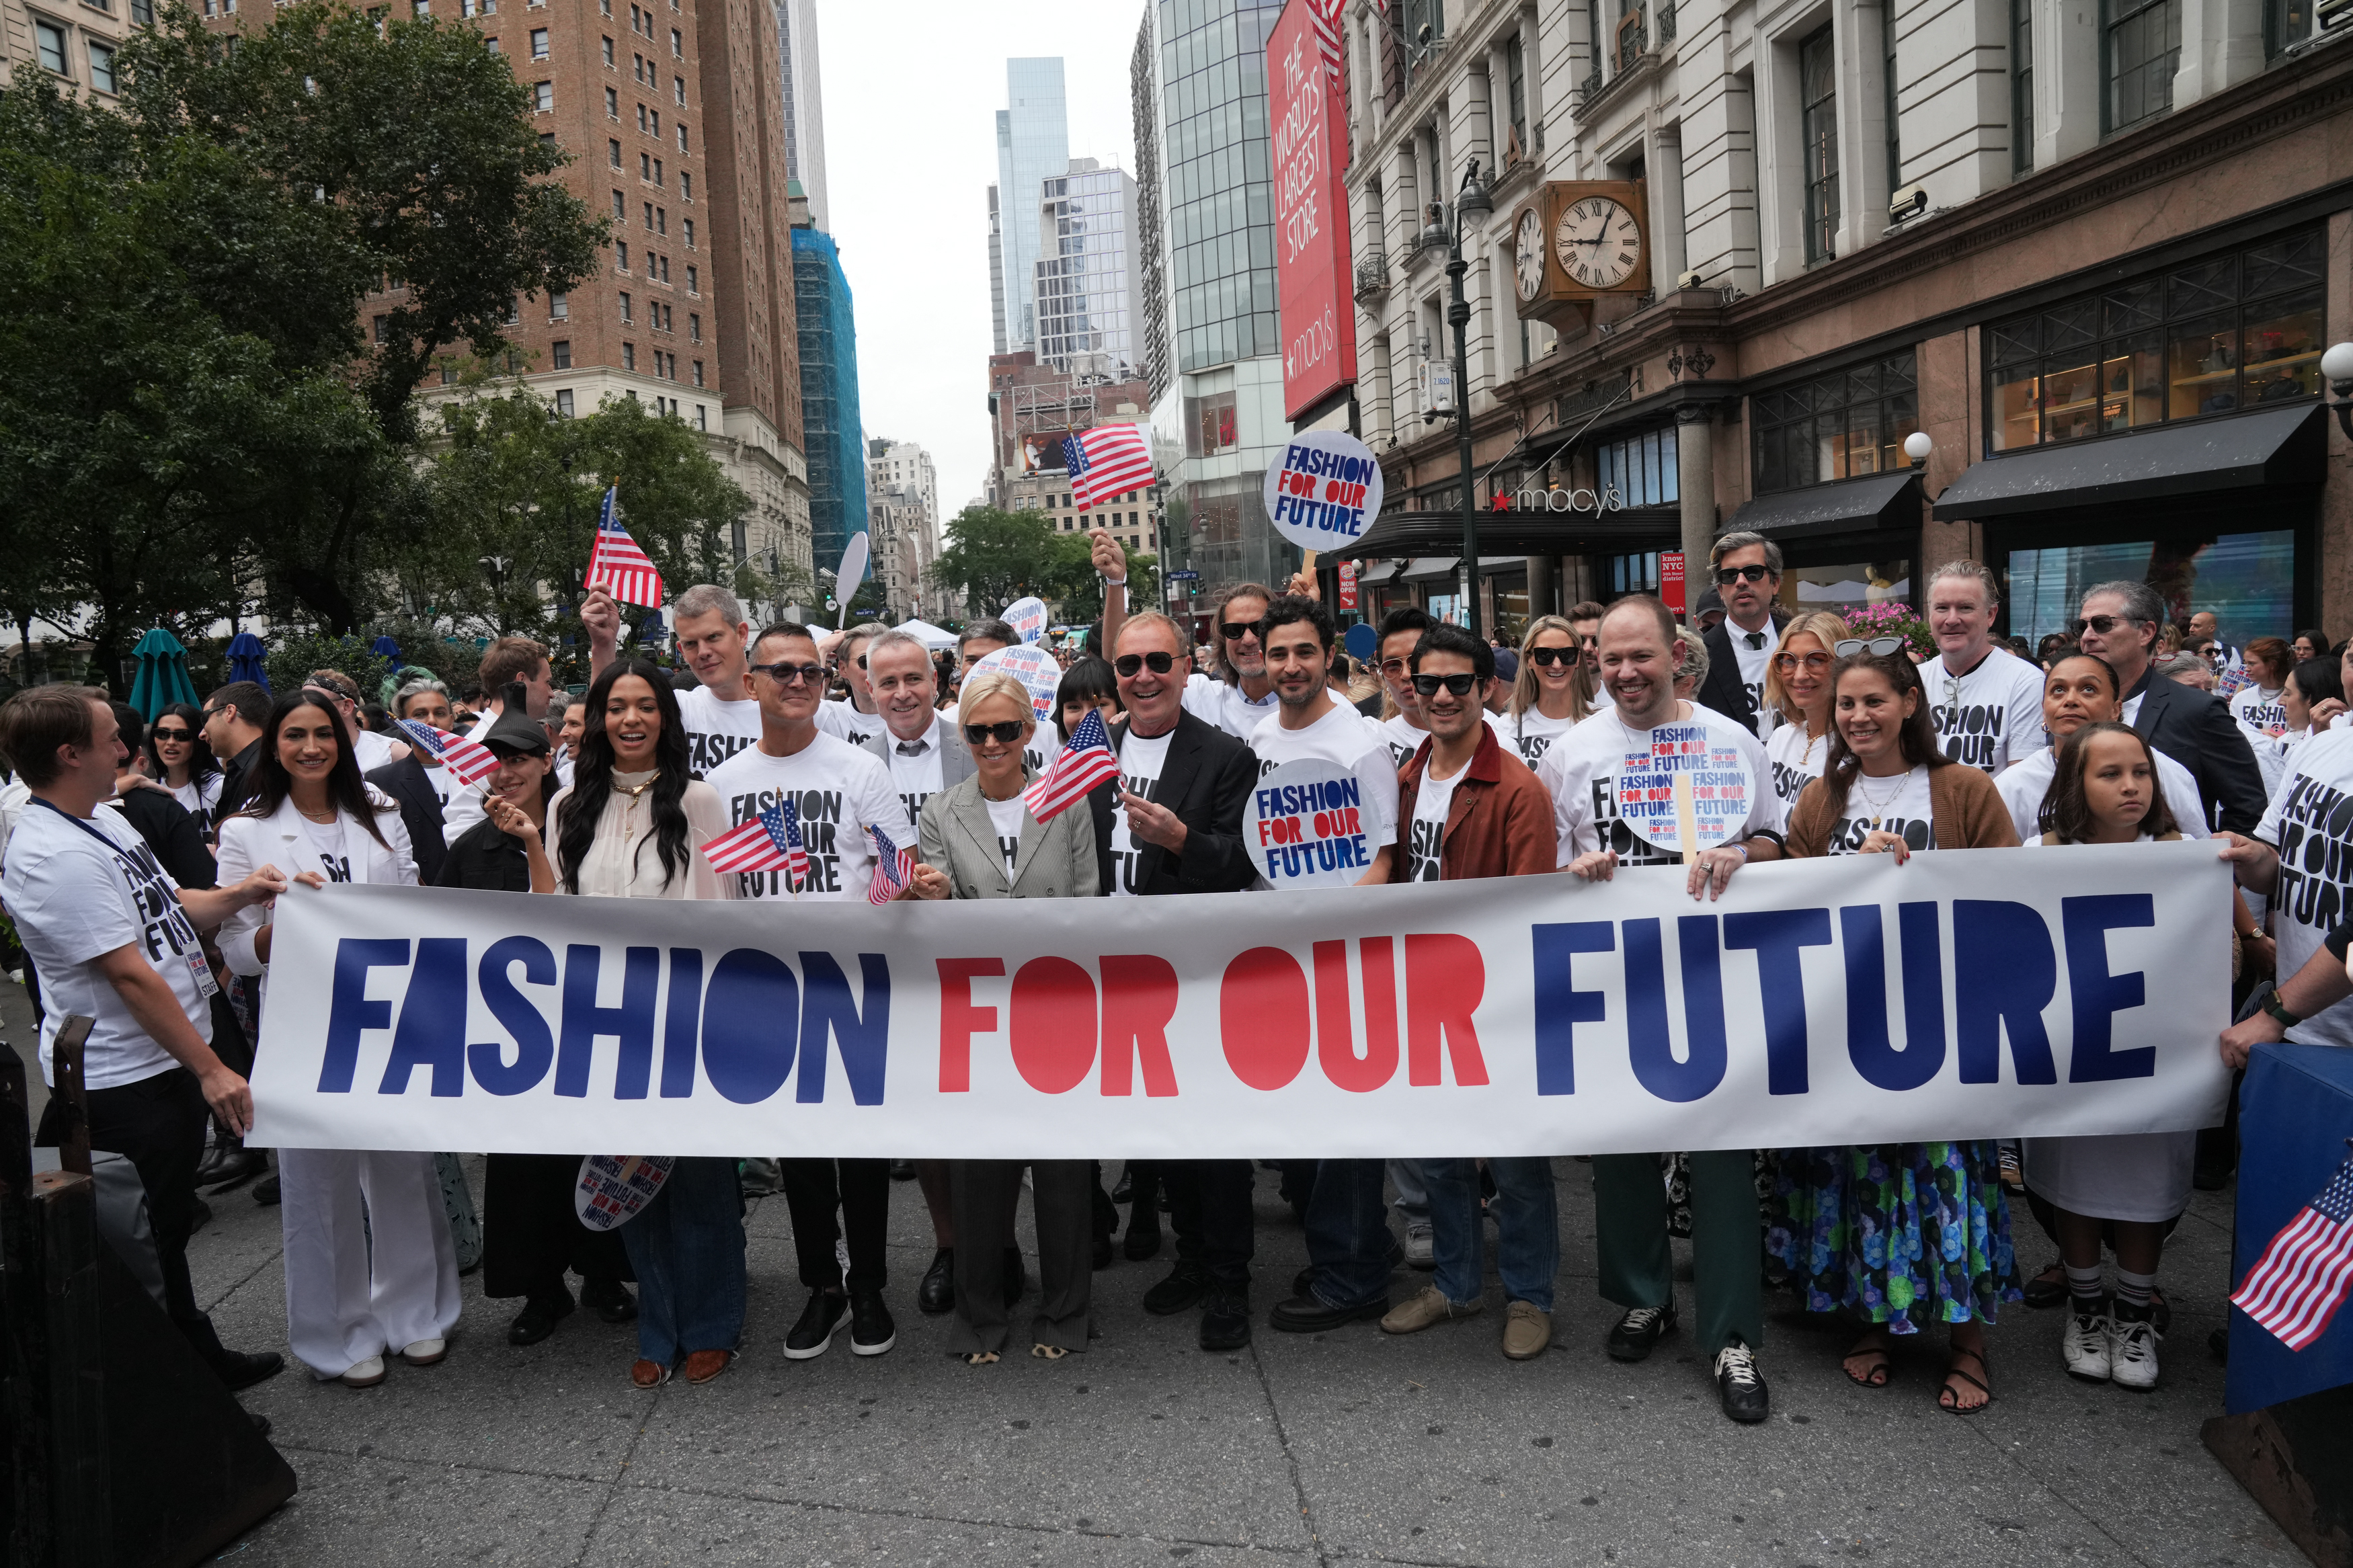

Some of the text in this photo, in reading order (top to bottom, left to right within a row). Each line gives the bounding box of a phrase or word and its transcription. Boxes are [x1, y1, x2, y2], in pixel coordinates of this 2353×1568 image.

[1283, 32, 1304, 101] THE
[1275, 65, 1320, 171] WORLD'S
[1278, 122, 1320, 221] LARGEST
[1287, 188, 1319, 264] STORE
[1284, 444, 1375, 487] FASHION
[1277, 470, 1366, 509] FOR OUR
[1517, 481, 1622, 519] macy's
[1274, 495, 1365, 537] FUTURE
[1002, 602, 1041, 625] FASHION
[1021, 615, 1039, 630] OUR
[1005, 648, 1045, 663] FASHION
[1000, 657, 1039, 672] FOR OUR
[1040, 669, 1058, 677] FASHION
[2223, 676, 2239, 686] FASHION
[1036, 679, 1055, 687] FUTURE
[2219, 685, 2235, 694] FUTURE
[1024, 685, 1055, 701] ASHION
[1033, 698, 1051, 710] OUR
[1931, 704, 2003, 737] SHION
[2243, 706, 2287, 722] FASHI
[1652, 727, 1707, 743] FASHION
[686, 731, 758, 769] FASH
[1625, 752, 1650, 760] FASHION
[1652, 741, 1706, 756] FOR OUR
[1946, 735, 1995, 765] OUR
[1626, 764, 1650, 773] FUTURE
[1654, 754, 1708, 772] FUTURE
[1620, 774, 1673, 790] FASHION
[1693, 772, 1745, 786] FASHION
[1256, 777, 1361, 819] FASHION
[1620, 787, 1672, 802] FOR OUR
[1693, 786, 1745, 799] FOR OUR
[1622, 800, 1675, 818] FUTURE
[1695, 799, 1747, 815] FUTURE
[1258, 807, 1362, 847] FOR OUR
[1649, 819, 1676, 827] FASHION
[797, 822, 836, 854] UR
[1650, 832, 1677, 841] FUTURE
[1699, 831, 1725, 839] FUTURE
[1266, 833, 1370, 879] FUTURE
[187, 950, 203, 962] FASHION
[190, 960, 198, 969] FOR
[194, 964, 209, 977] FUTURE
[202, 981, 216, 996] STAFF
[317, 893, 2157, 1106] FASHION FOR OUR FUTURE
[584, 1176, 592, 1185] OUR
[586, 1169, 603, 1183] FUTURE
[637, 1161, 666, 1184] FOR OUR
[579, 1182, 596, 1195] FASHION
[598, 1178, 633, 1203] FUTURE
[627, 1172, 658, 1196] FASHION
[592, 1192, 624, 1216] FOR OUR
[582, 1203, 616, 1229] FASHION
